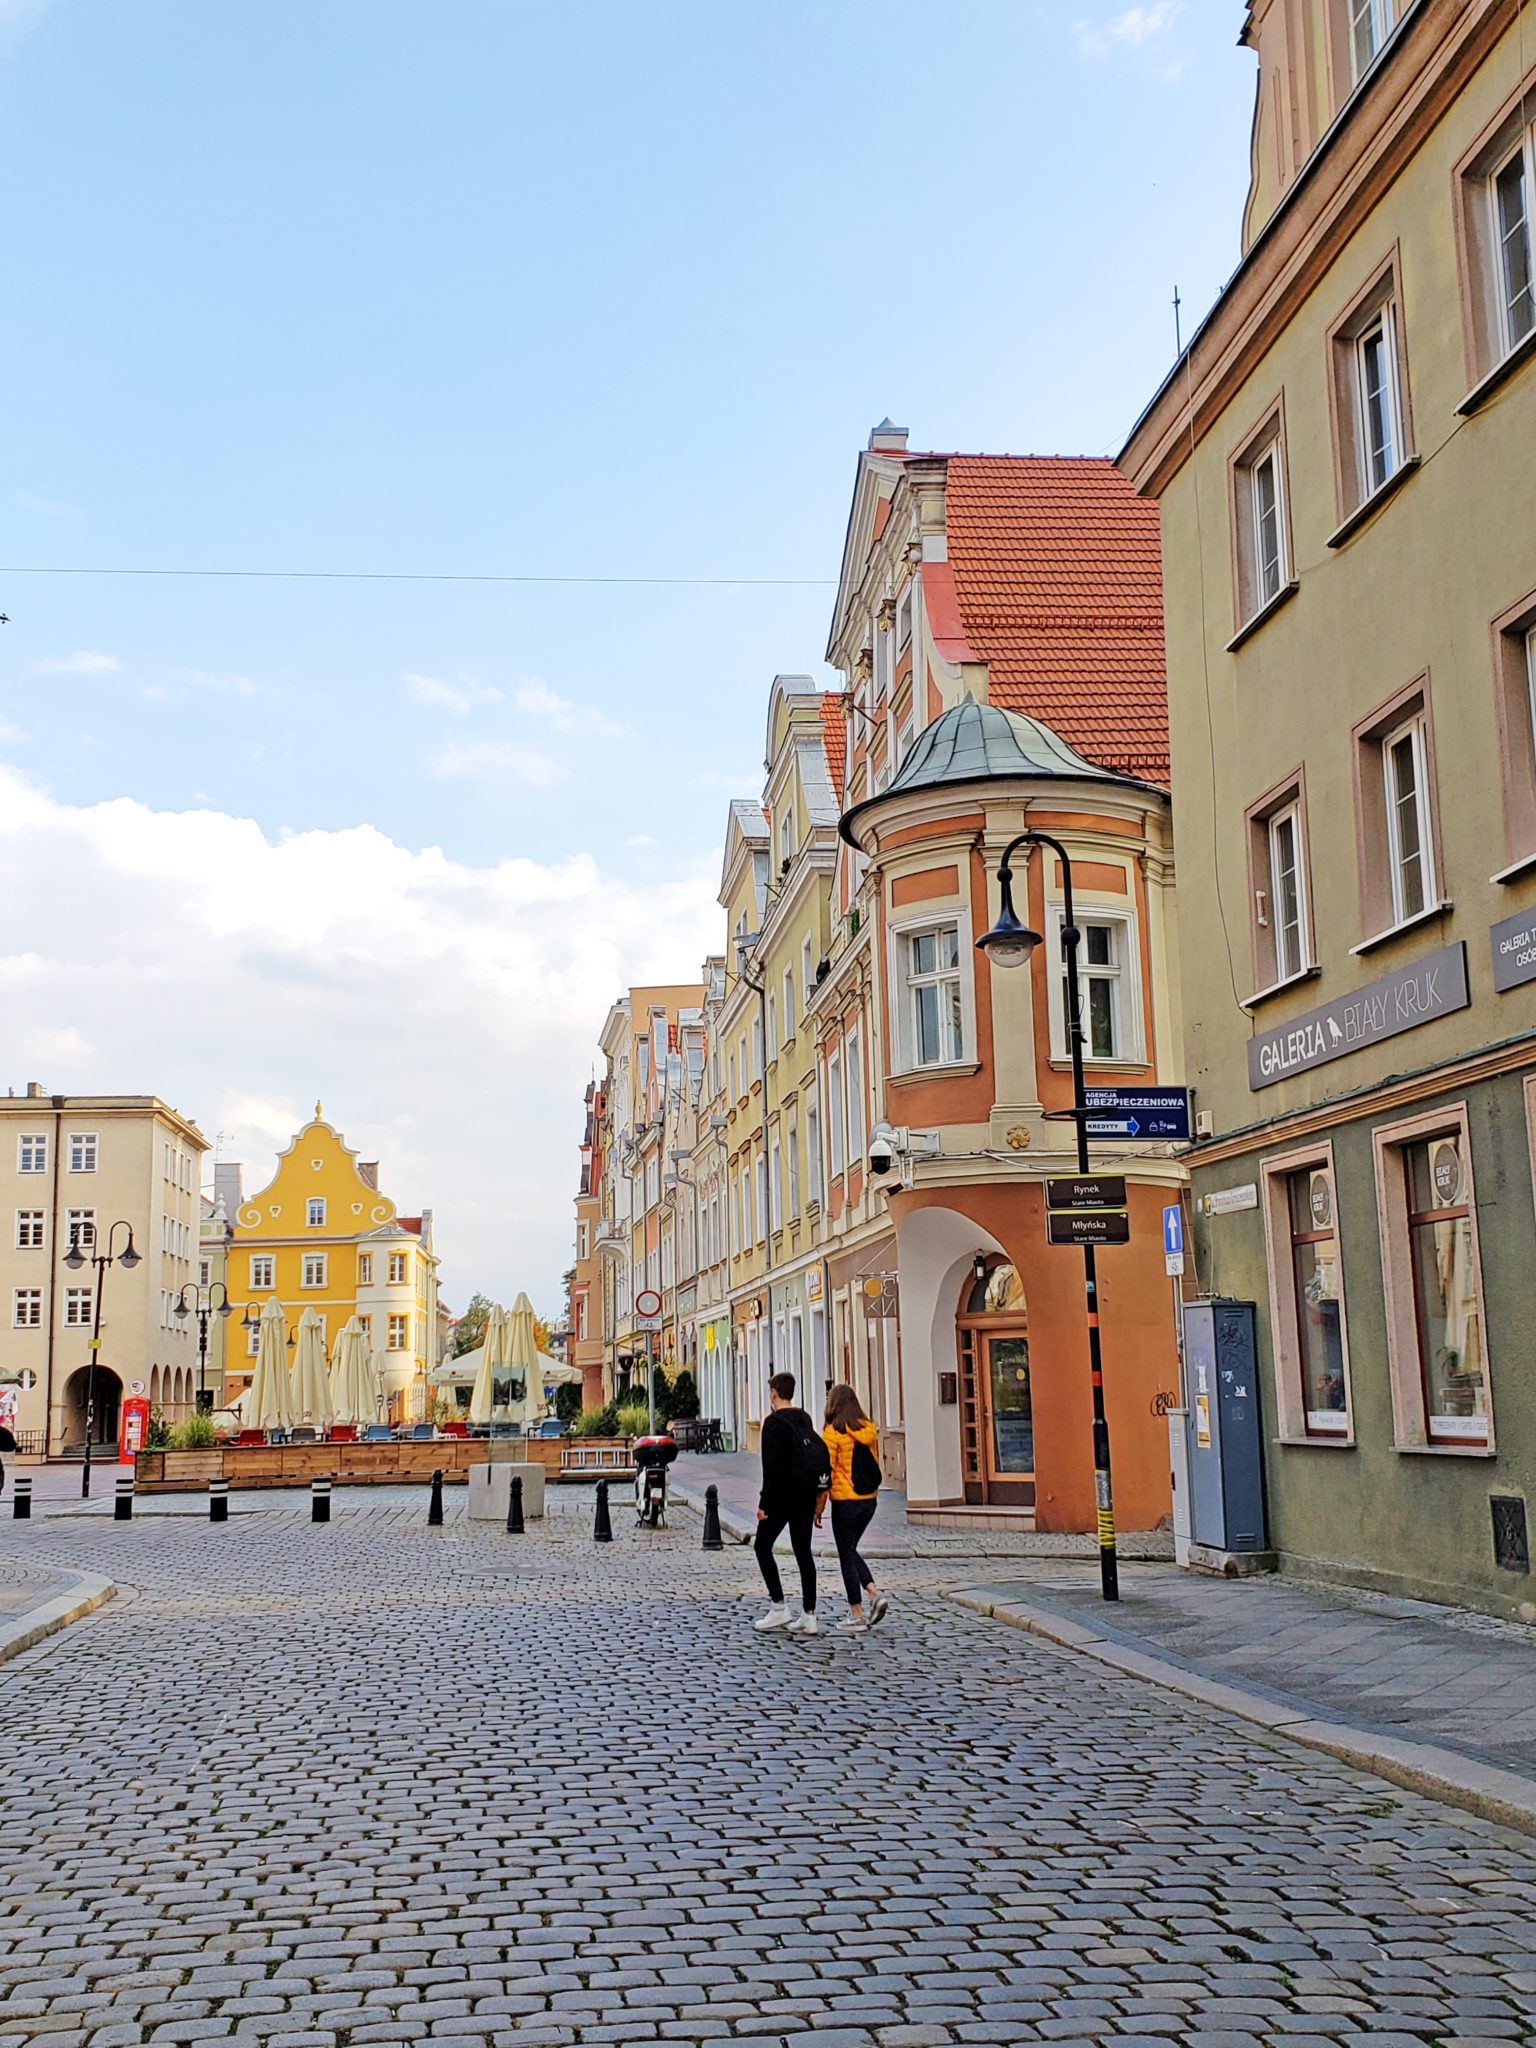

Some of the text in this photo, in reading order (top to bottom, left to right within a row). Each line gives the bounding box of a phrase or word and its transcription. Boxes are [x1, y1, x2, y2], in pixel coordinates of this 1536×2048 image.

[1500, 931, 1530, 954] GALERIA
[1260, 967, 1443, 1076] GALERIA BIAŁY KRUK
[1085, 1098, 1185, 1107] UBEZPIECZENIOWA
[1073, 1184, 1100, 1196] Rynek
[1072, 1220, 1107, 1231] Młyńska
